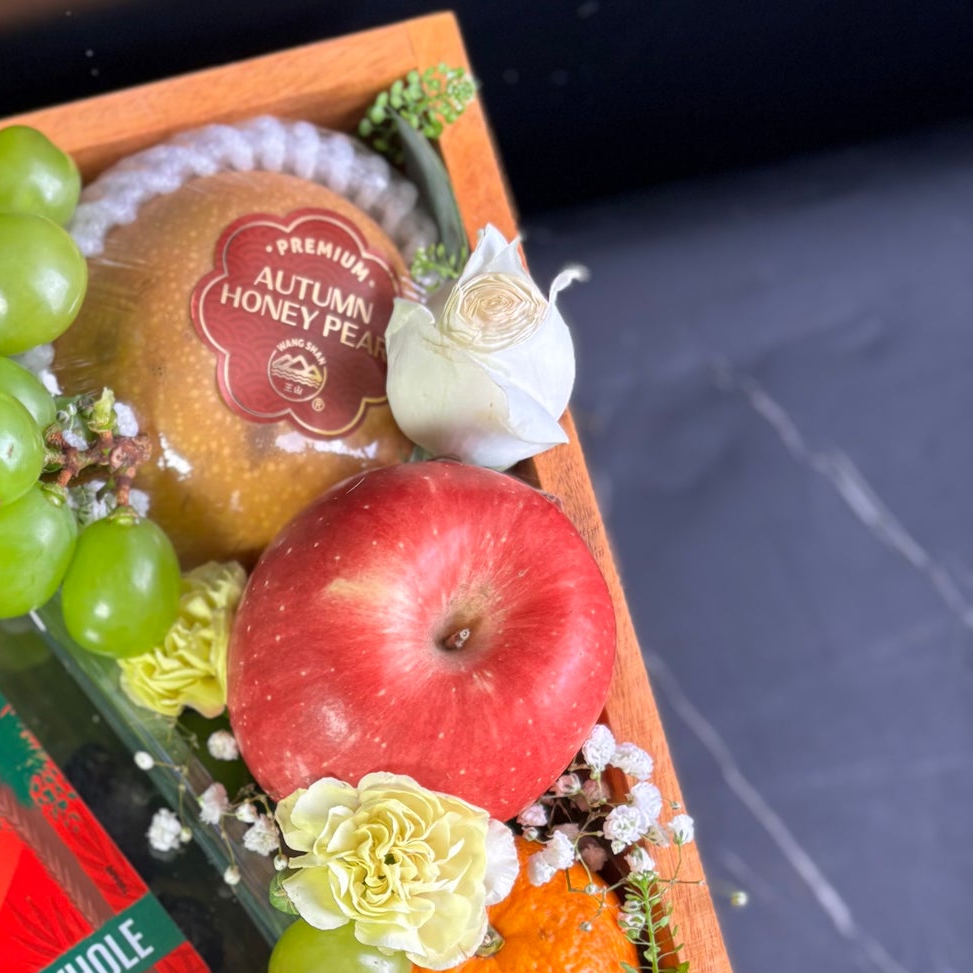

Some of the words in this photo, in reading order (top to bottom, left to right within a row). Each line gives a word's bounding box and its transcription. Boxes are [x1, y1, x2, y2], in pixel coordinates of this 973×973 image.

[276, 237, 370, 282] PREMIUM
[220, 284, 319, 331] HONEY
[254, 266, 374, 324] AUTUMN
[276, 338, 305, 353] WANG
[304, 342, 327, 366] SHAN
